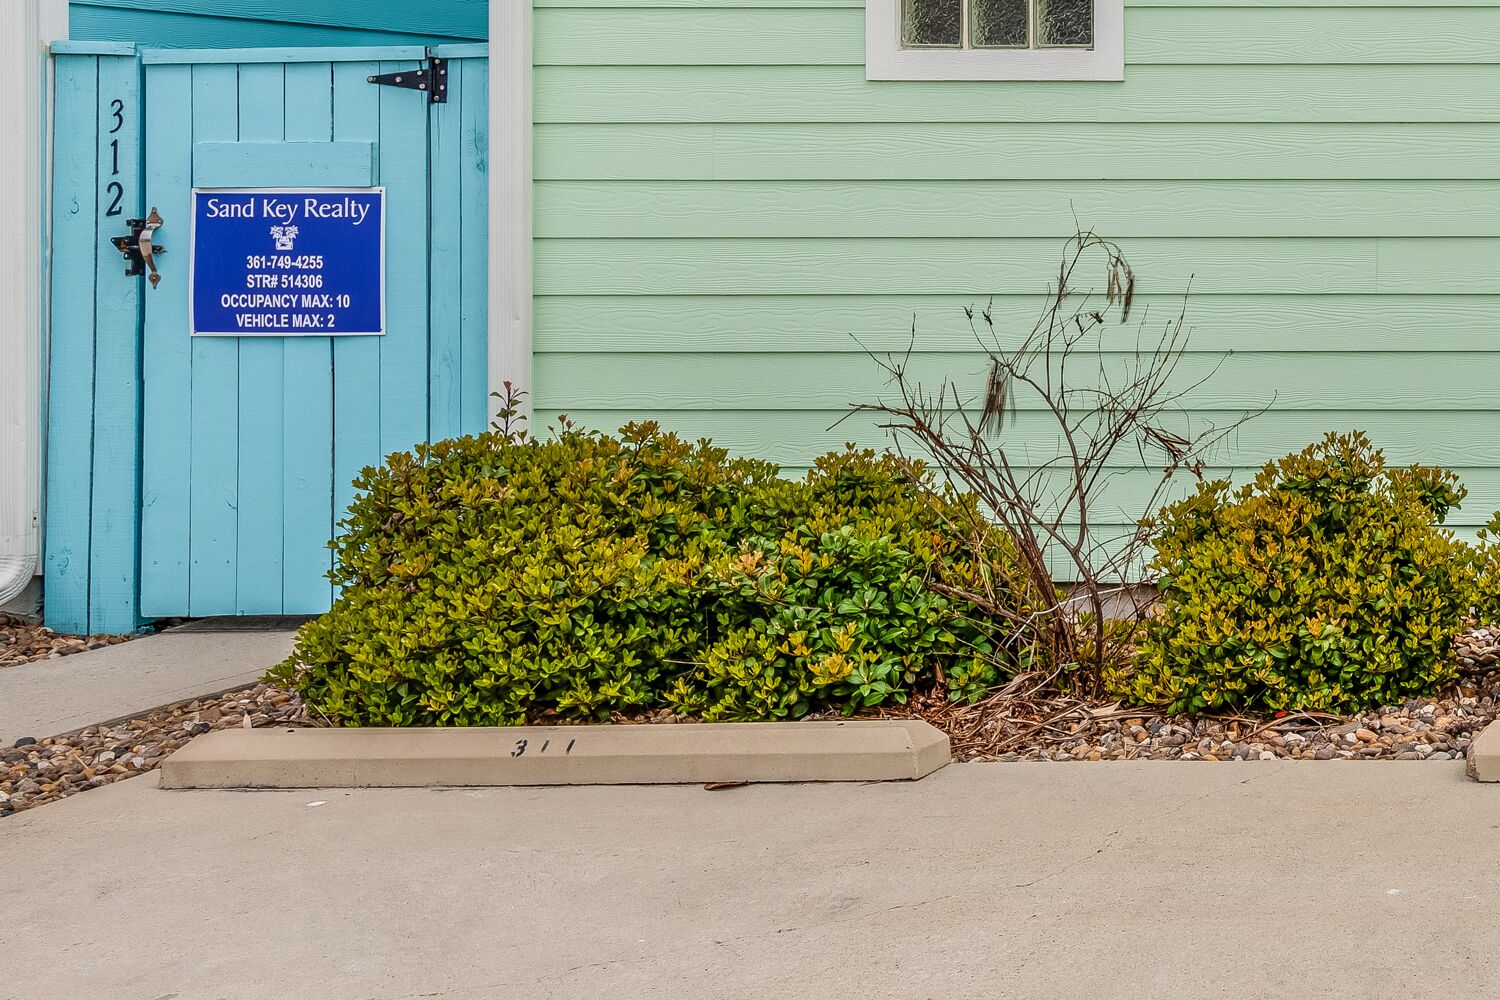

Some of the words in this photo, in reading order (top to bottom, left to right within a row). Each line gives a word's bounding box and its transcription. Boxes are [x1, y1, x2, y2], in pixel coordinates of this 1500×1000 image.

[105, 99, 124, 217] 312
[206, 197, 255, 218] Sand
[263, 198, 298, 225] Key
[304, 197, 371, 226] Realty
[246, 255, 324, 269] 361-749-4255
[246, 274, 278, 289] STR#
[281, 274, 323, 289] 514306
[221, 294, 299, 308] OCCUPANCY
[301, 294, 333, 308] MAX:
[336, 294, 350, 308] 10
[236, 313, 289, 328] VEHICLE
[292, 314, 324, 328] MAX:
[327, 313, 335, 328] 2
[511, 739, 576, 758] 311
